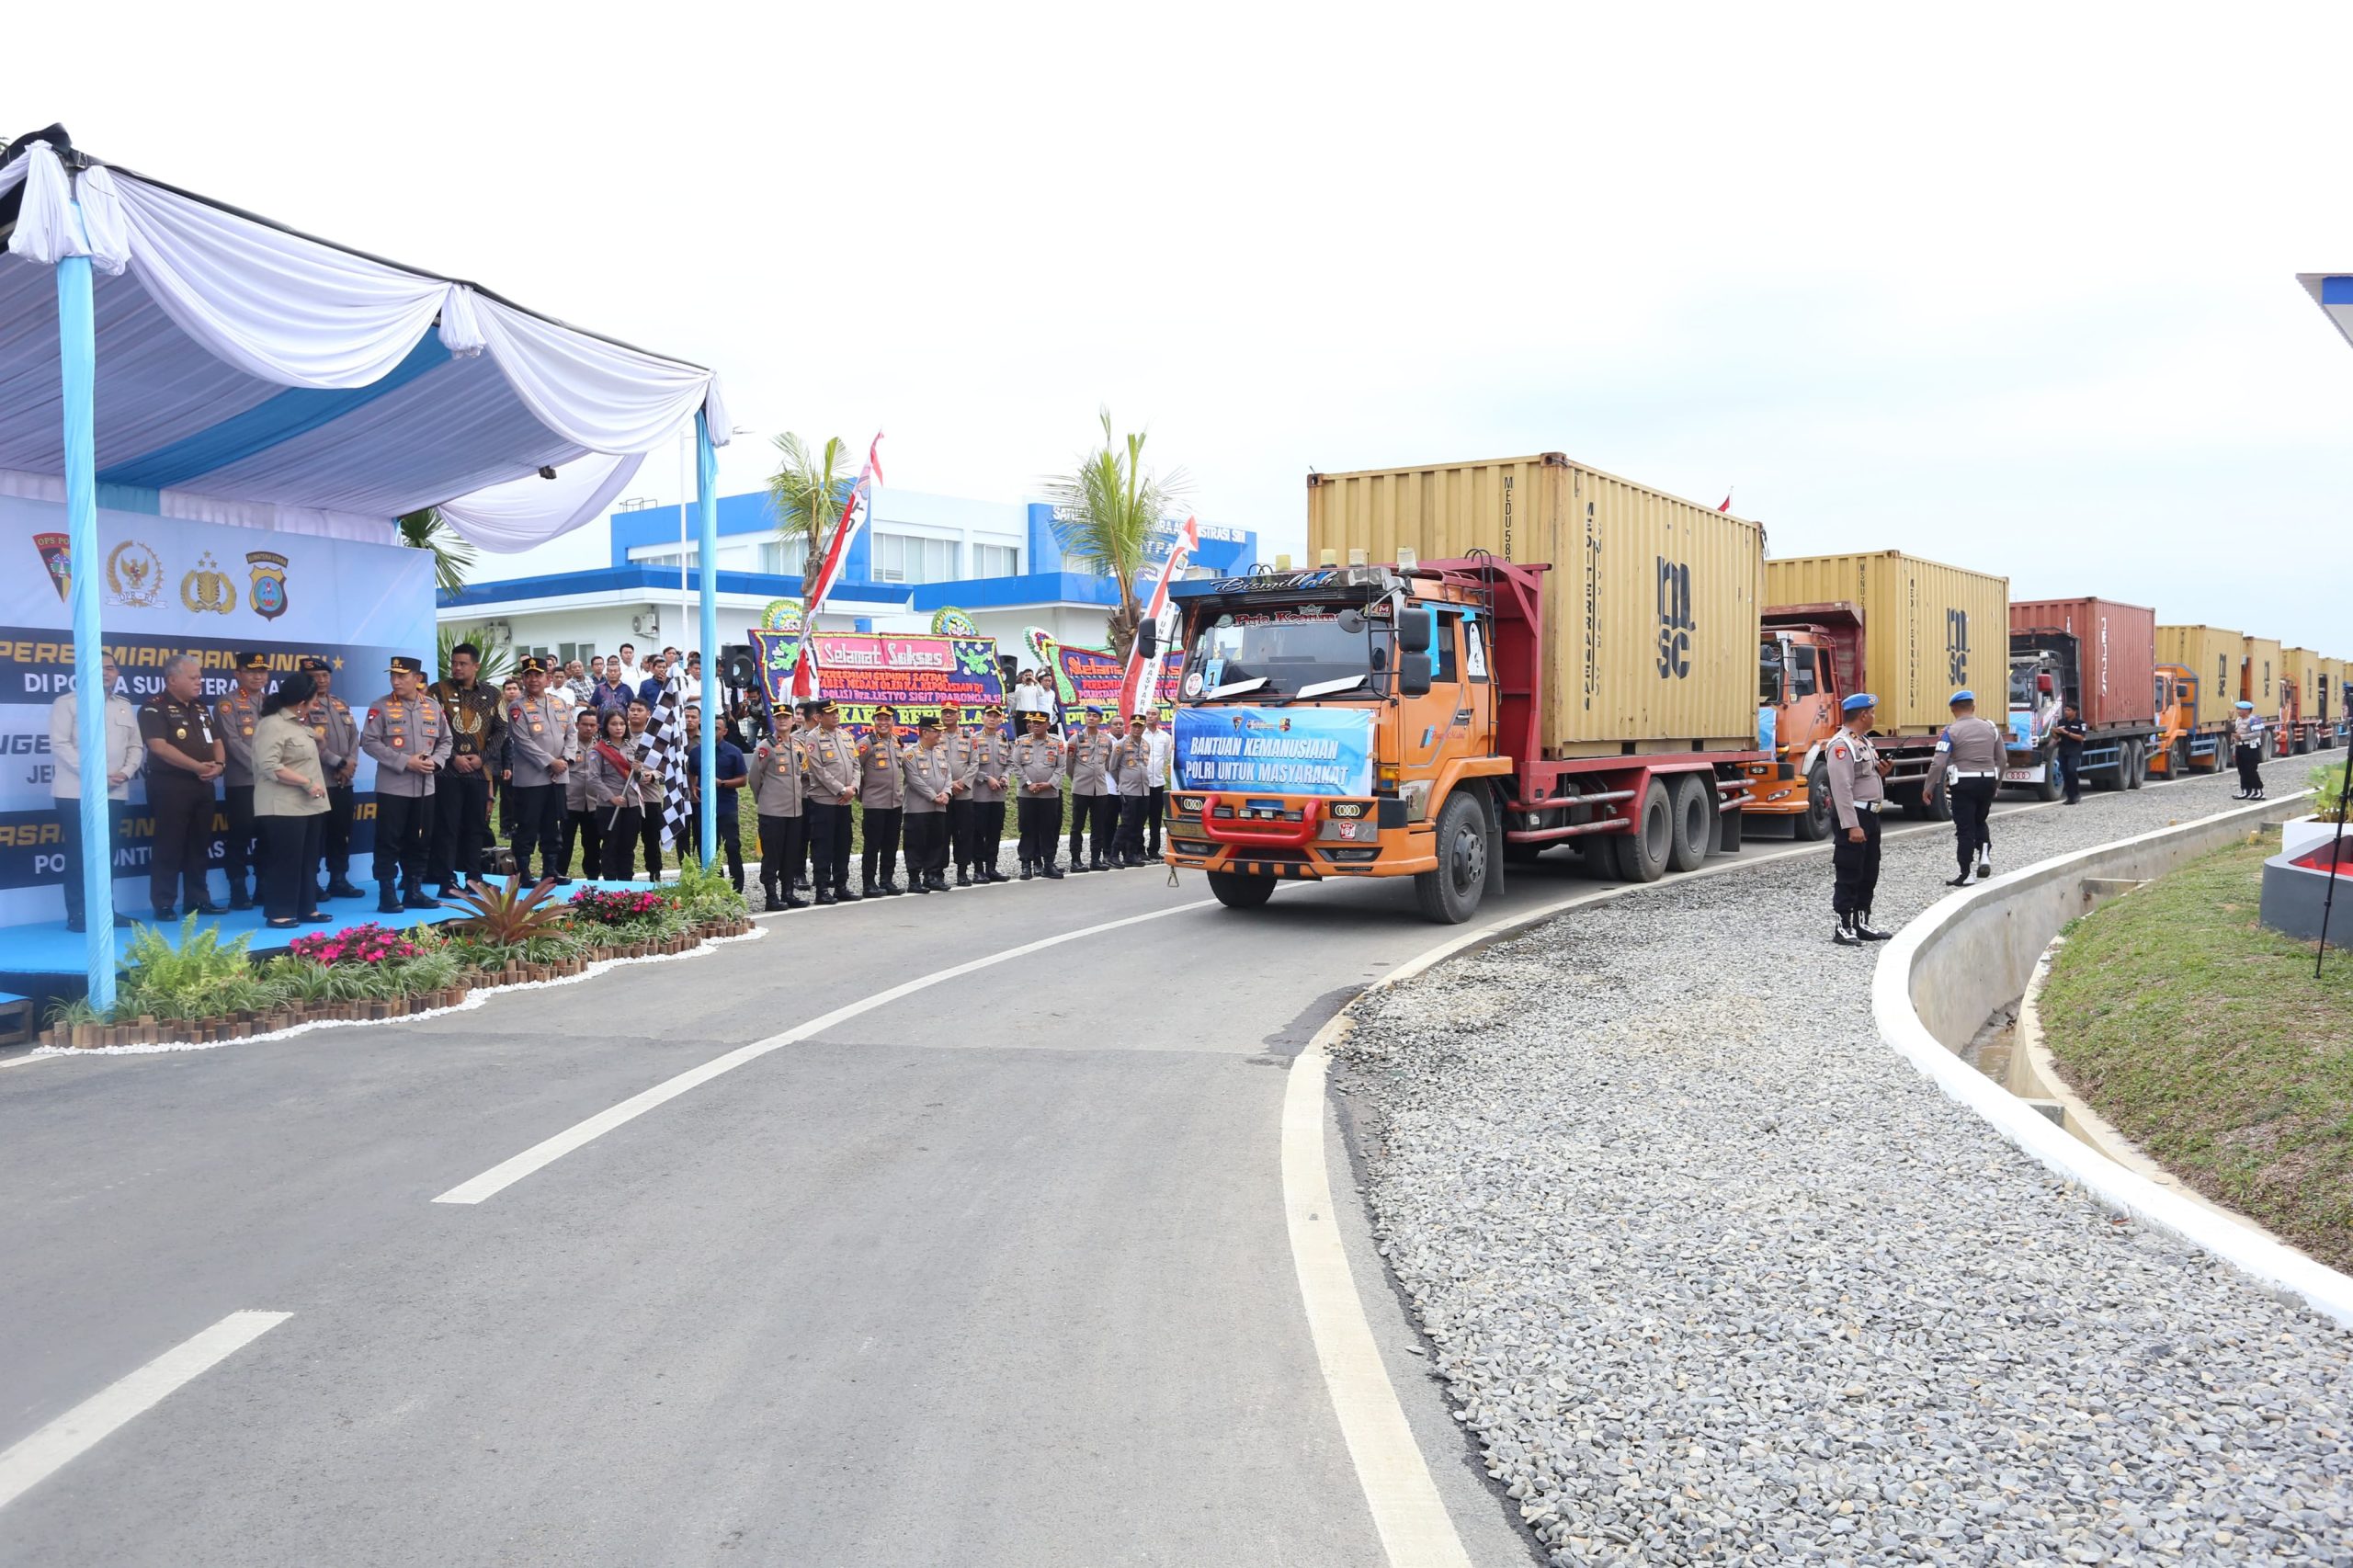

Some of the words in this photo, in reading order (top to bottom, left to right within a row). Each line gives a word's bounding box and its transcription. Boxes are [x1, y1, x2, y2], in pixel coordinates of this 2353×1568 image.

[37, 536, 55, 546] OPS
[1210, 571, 1338, 593] Bismillah
[1584, 501, 1595, 711] MEDITERRANEAN
[1233, 613, 1271, 630] Puja
[0, 641, 179, 667] PEREMIAN
[824, 642, 881, 665] Selamat
[887, 642, 943, 666] Sukses
[25, 673, 49, 693] DI
[1208, 671, 1216, 686] 1
[909, 691, 934, 702] SIGIT
[1190, 736, 1242, 756] BANTUAN
[1244, 737, 1339, 760] KEMANUSIAAN
[1186, 760, 1215, 780] POLRI
[1217, 761, 1255, 781] UNTUK
[1258, 763, 1349, 786] MASYARAKAT
